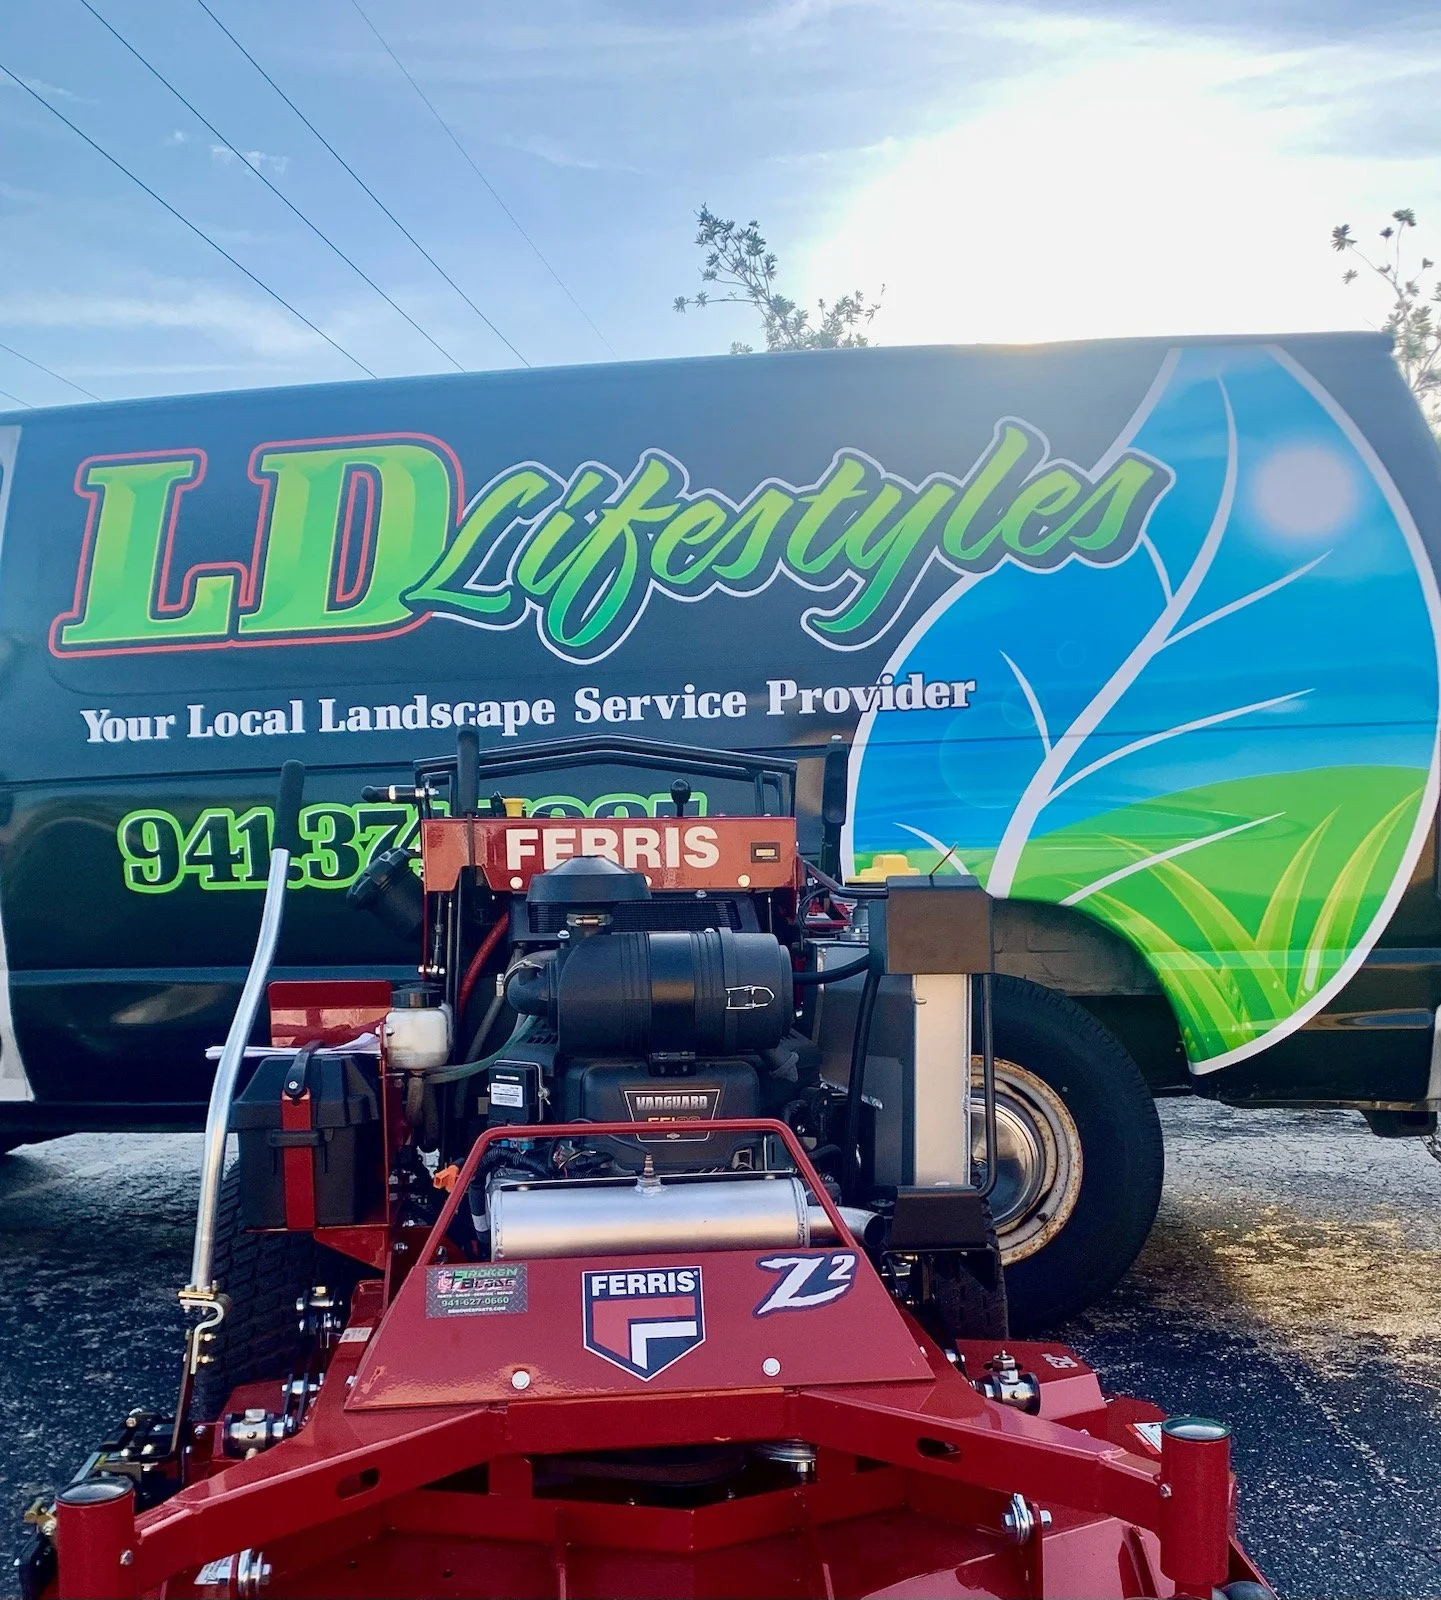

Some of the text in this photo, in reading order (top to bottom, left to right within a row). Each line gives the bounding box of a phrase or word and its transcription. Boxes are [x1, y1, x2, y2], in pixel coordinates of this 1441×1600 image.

[50, 417, 1176, 664] LD Lifestyles
[80, 673, 977, 743] Your Local Landscape Service Provider
[505, 826, 720, 870] FERRIS
[635, 1095, 708, 1110] VANGUARD
[591, 1271, 696, 1297] FERRIS
